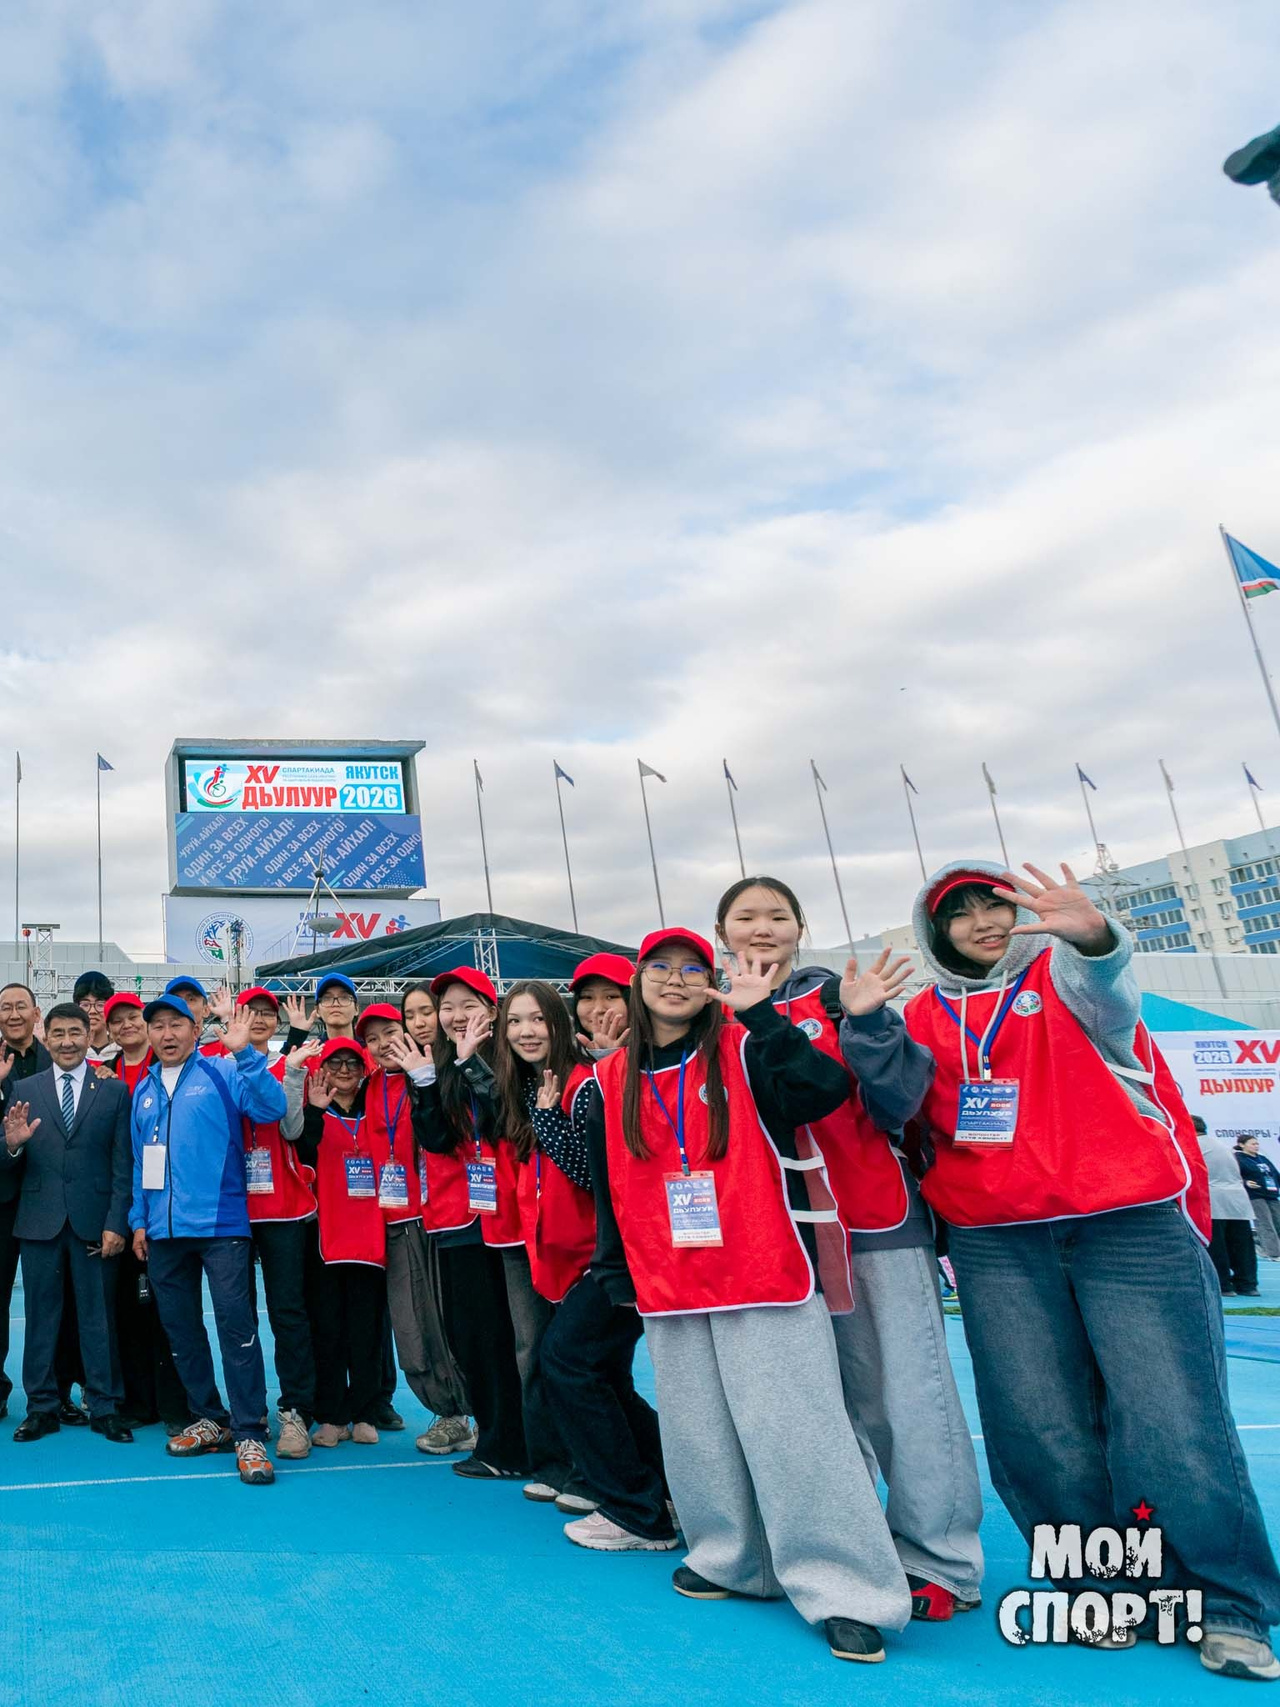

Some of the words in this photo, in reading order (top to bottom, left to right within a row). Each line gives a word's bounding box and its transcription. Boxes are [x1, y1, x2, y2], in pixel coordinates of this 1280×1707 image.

[245, 766, 280, 784] XV
[282, 767, 335, 775] СПАРТАКИАДА
[346, 766, 398, 780] ЯКУТСК
[242, 786, 338, 810] ДЬУЛУУР
[343, 786, 398, 808] 2026
[184, 850, 214, 878] ОДИН
[209, 840, 227, 854] ЗА
[221, 816, 249, 842] ВСЕХ
[198, 876, 210, 887] И
[206, 860, 227, 879] ВСЕ
[222, 850, 238, 864] ЗА
[233, 816, 272, 852] ОДНОГО!
[225, 818, 296, 885] УРУЙ-АЙХАЛ!
[264, 850, 291, 875] ОДИН
[286, 840, 302, 853] ЗА
[297, 820, 321, 844] ВСЕХ
[307, 819, 376, 882] УУЙ-АЙХАЛ!
[342, 862, 369, 888] ОДИН
[365, 852, 380, 866] ЗА
[375, 832, 400, 856] ВСЕХ
[282, 862, 303, 884] ВСЕ
[363, 879, 375, 888] И
[372, 864, 391, 884] ВСЕ
[386, 855, 401, 868] ЗА
[332, 912, 381, 938] XV
[1195, 1051, 1230, 1064] 2026
[1200, 1078, 1275, 1095] ДЬУЛУУР
[963, 1097, 990, 1109] XV
[246, 1160, 257, 1168] XV
[349, 1166, 360, 1174] XV
[470, 1173, 482, 1182] XV
[673, 1193, 692, 1206] XV
